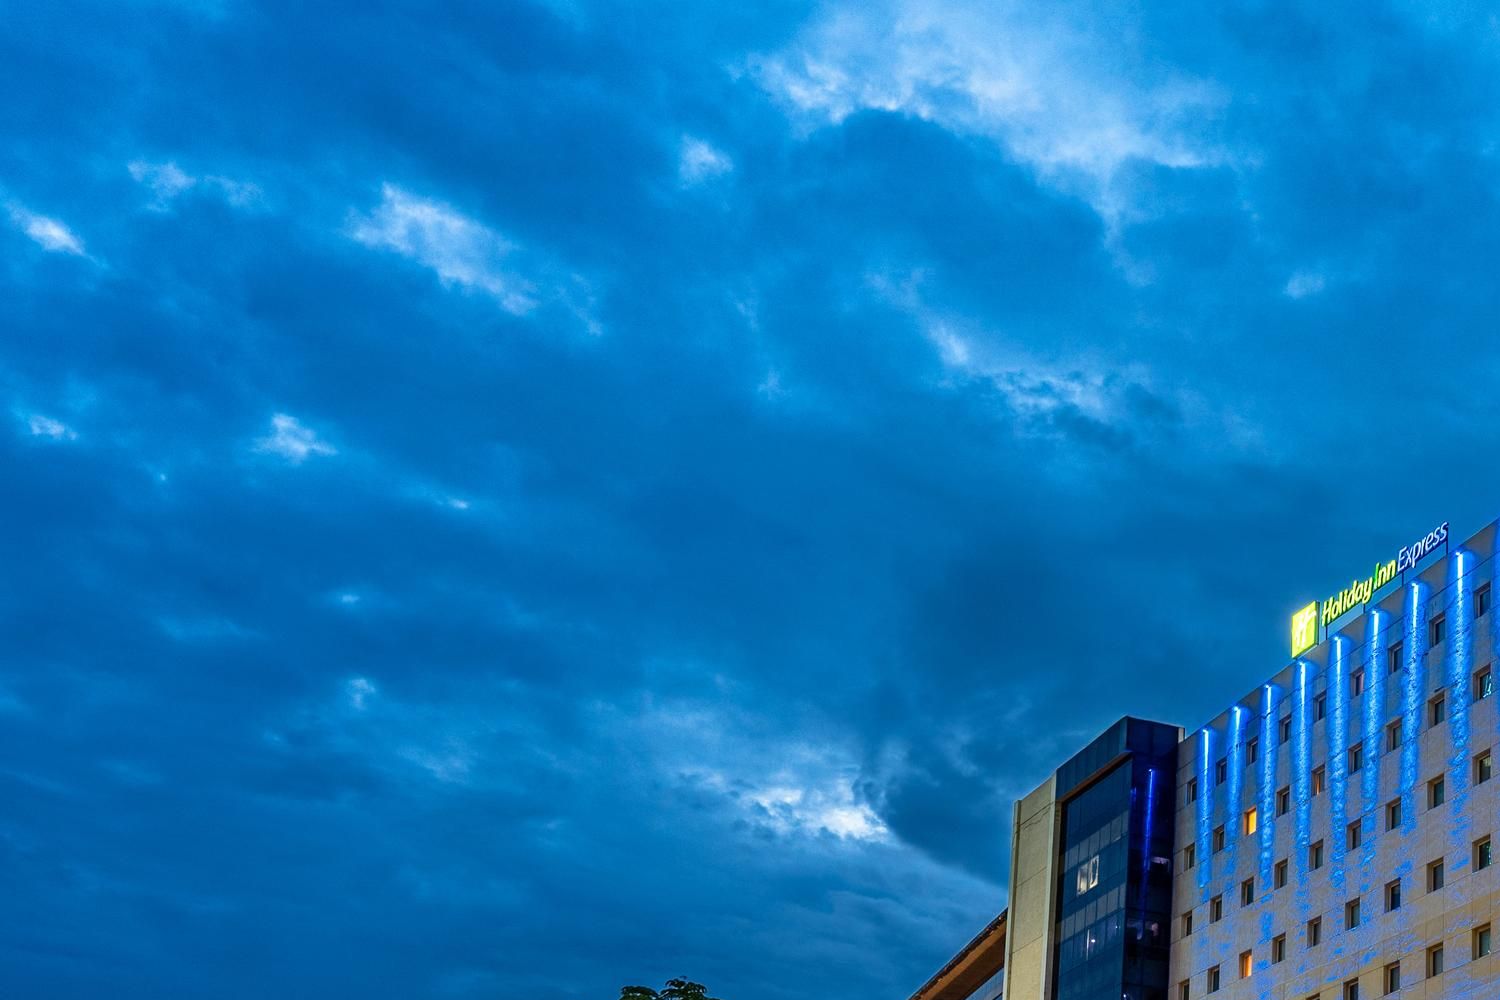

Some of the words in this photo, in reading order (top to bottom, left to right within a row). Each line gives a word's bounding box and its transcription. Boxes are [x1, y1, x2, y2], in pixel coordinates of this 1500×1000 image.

[1321, 576, 1373, 627] Holiday
[1373, 559, 1397, 589] Inn
[1397, 521, 1449, 572] Express
